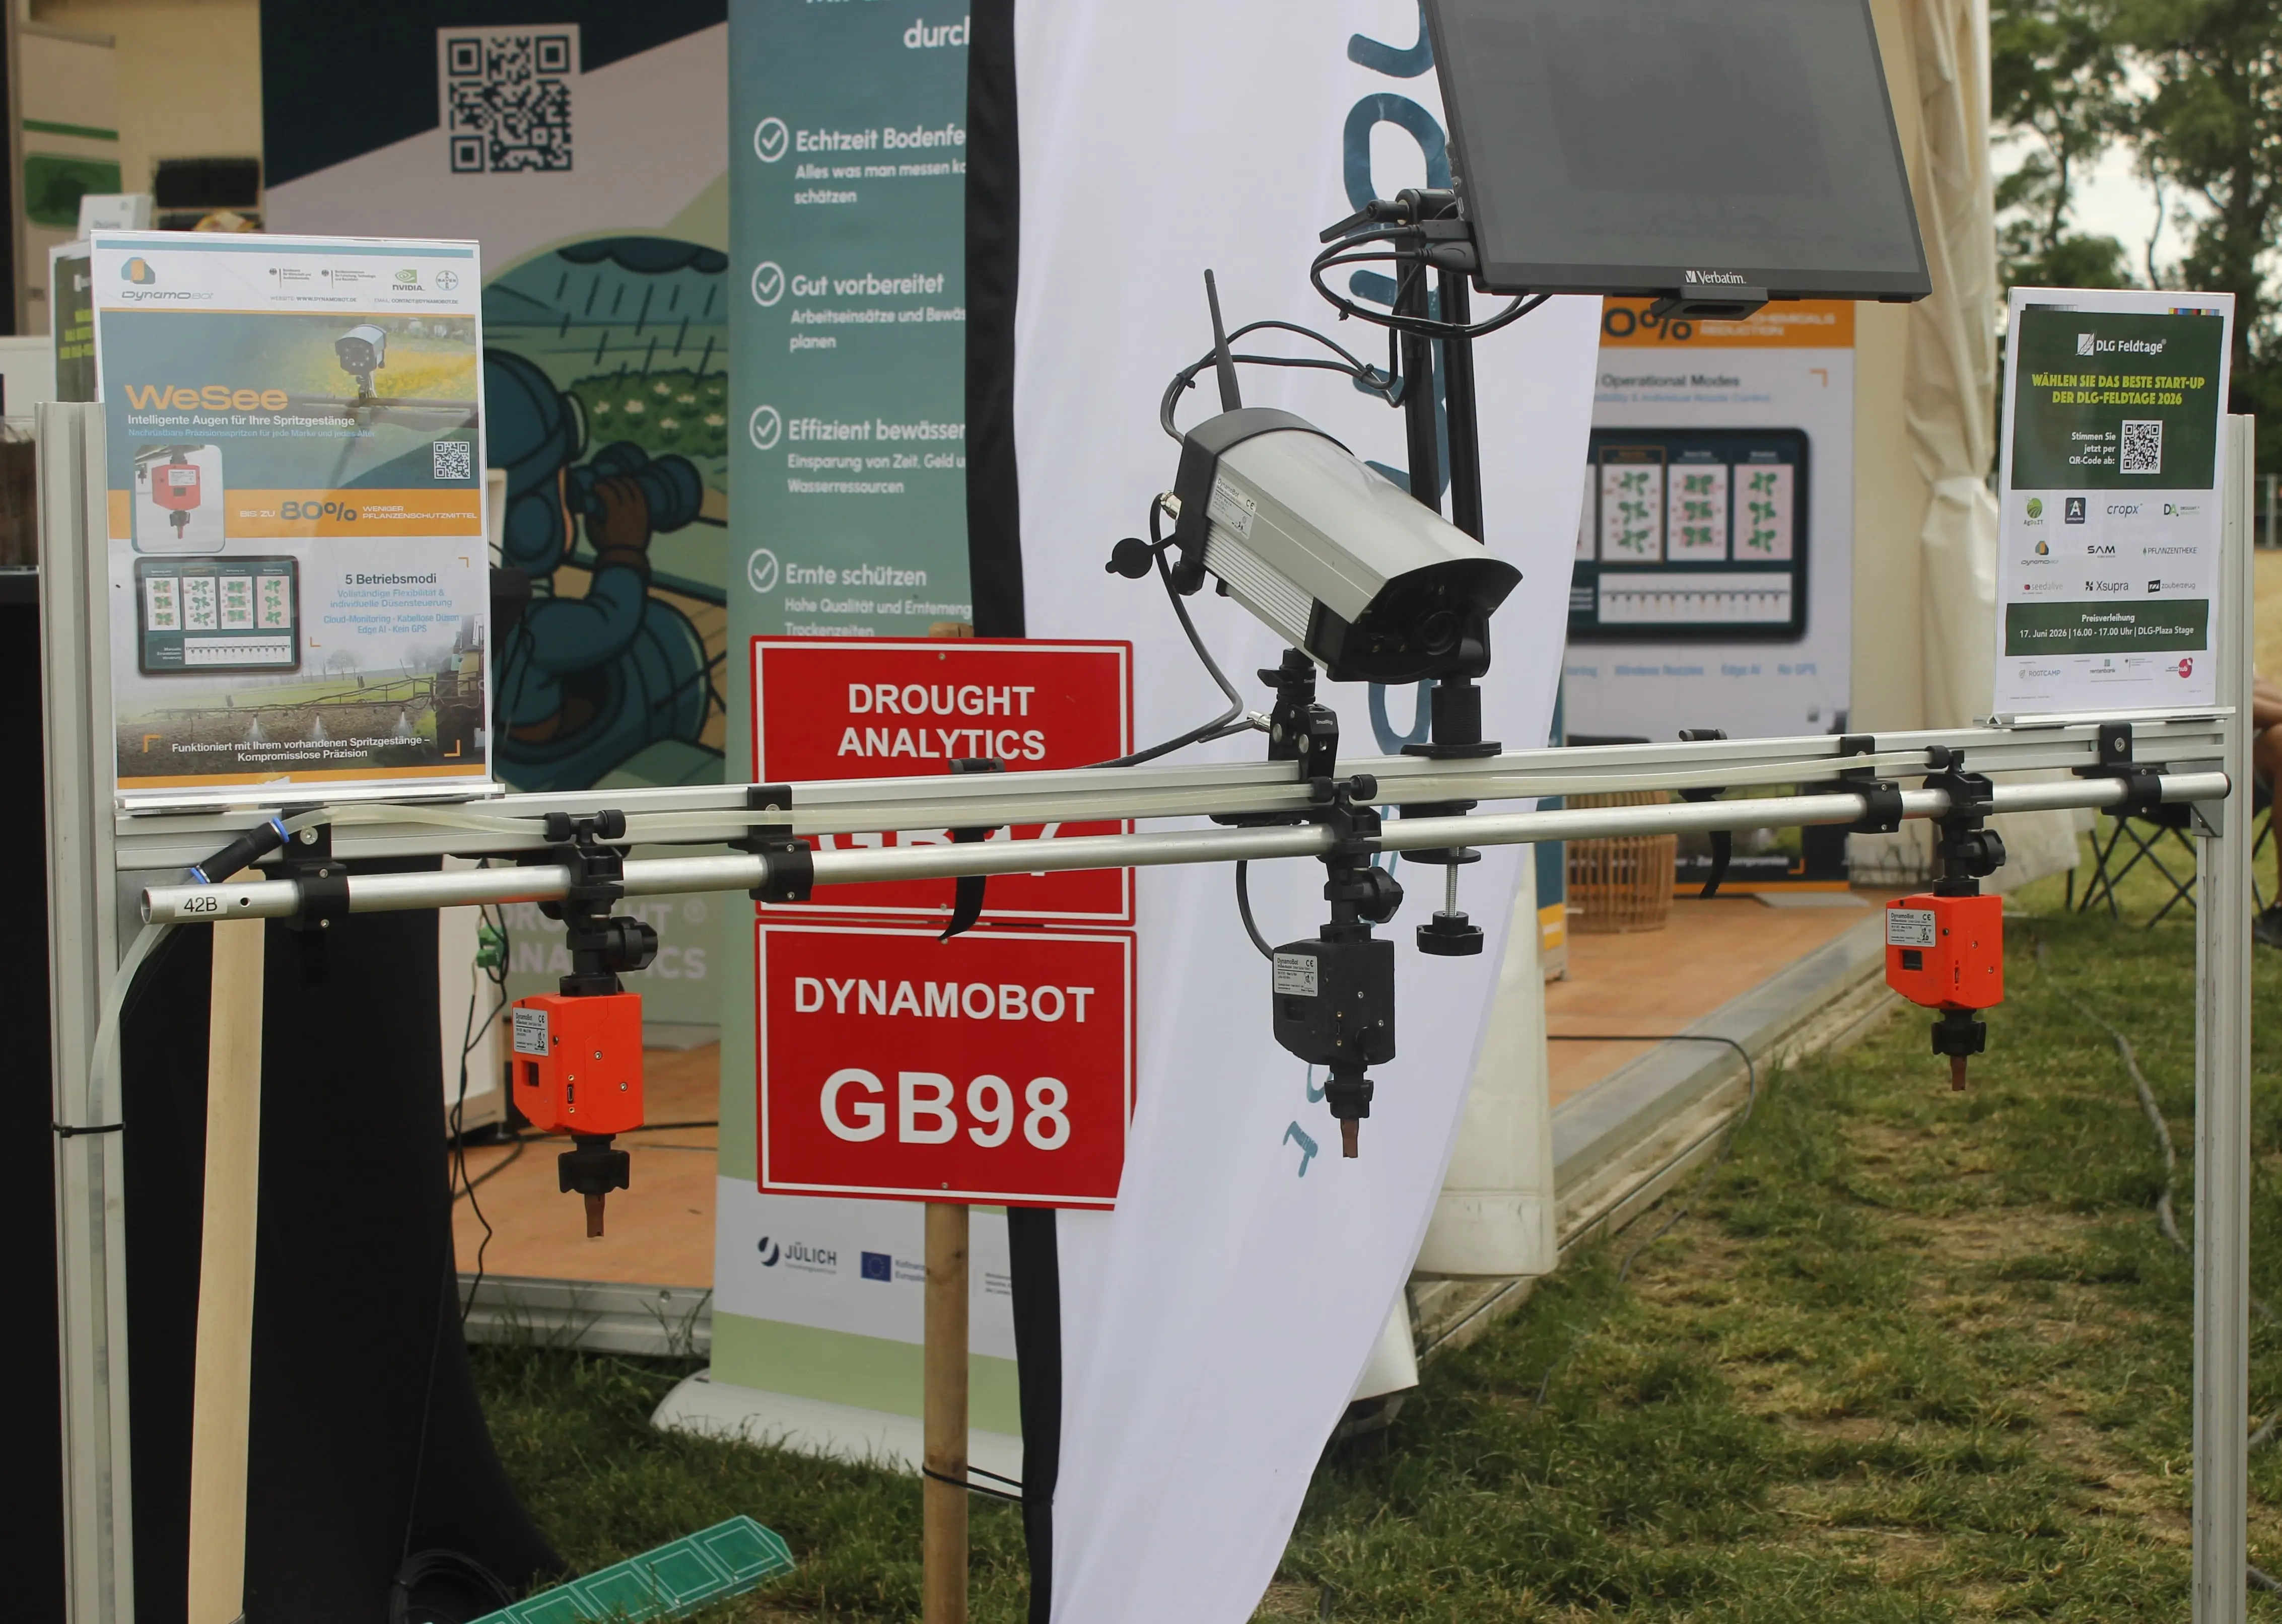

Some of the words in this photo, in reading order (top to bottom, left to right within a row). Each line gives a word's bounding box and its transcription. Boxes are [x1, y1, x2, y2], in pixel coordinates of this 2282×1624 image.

[797, 128, 878, 152] Echtzeit
[795, 164, 828, 179] Alles
[833, 166, 861, 178] was
[864, 165, 896, 177] man
[899, 163, 949, 176] messen
[794, 188, 857, 204] schätzen
[791, 275, 828, 297] Gut
[834, 273, 944, 295] vorbereitet
[791, 309, 895, 324] Arbeitseinsätze
[898, 308, 924, 322] und
[790, 333, 837, 353] planen
[2096, 340, 2115, 352] DLG
[2118, 340, 2163, 355] Feldtage
[1691, 374, 1740, 387] Modes
[2032, 372, 2077, 387] WÄHLEN
[2080, 375, 2096, 387] SIE
[2098, 376, 2119, 388] DAS
[2122, 376, 2152, 388] BESTE
[2155, 377, 2205, 389] START-UP
[125, 385, 289, 411] WeSee
[2052, 391, 2074, 403] DER
[2077, 392, 2155, 404] DLG-FELDTAGE
[2159, 392, 2182, 405] 2026
[128, 414, 189, 427] Intelligente
[193, 415, 229, 428] Augen
[231, 415, 246, 426] für
[250, 415, 270, 426] Ihre
[273, 415, 355, 429] Spritzgestänge
[789, 418, 870, 440] Effizient
[876, 418, 965, 440] bewässer
[128, 429, 183, 437] Nachrüstbare
[185, 429, 257, 438] Präzisionsspritzen
[272, 429, 289, 439] jede
[2071, 432, 2103, 441] Stimmen
[2105, 433, 2116, 441] Sie
[2084, 444, 2101, 454] jetzt
[2103, 445, 2115, 454] per
[788, 454, 862, 472] Einsparung
[866, 457, 889, 468] von
[924, 453, 954, 468] Geld
[2069, 456, 2101, 465] QR-Code
[2103, 456, 2115, 465] ab:
[788, 479, 904, 494] Wasserressourcen
[280, 501, 358, 522] 80%
[345, 574, 352, 585] 5
[356, 573, 437, 585] Betriebsmodi
[786, 563, 837, 585] Ernte
[842, 563, 926, 586] schützen
[2031, 581, 2063, 590] seedalive
[2096, 581, 2128, 593] Xsupra
[337, 590, 390, 599] Vollständige
[393, 589, 436, 597] Flexibilität
[330, 599, 379, 608] individuelle
[381, 599, 452, 608] Düsensteuerung
[785, 597, 817, 612] Hohe
[820, 598, 874, 613] Qualität
[877, 599, 901, 614] und
[905, 601, 972, 619] Erntemeng
[324, 615, 391, 624] Cloud-Monitoring
[397, 614, 434, 622] Kabellose
[436, 613, 459, 622] Düsen
[2082, 614, 2135, 623] Preisverleihung
[358, 625, 377, 635] Edge
[393, 625, 409, 633] Kein
[412, 624, 427, 632] GPS
[784, 622, 874, 637] Trockenzeiten
[2033, 629, 2047, 637] Juni
[2049, 629, 2066, 637] 2026
[2073, 628, 2092, 637] 16.00
[2099, 627, 2118, 636] 17.00
[2120, 627, 2133, 636] Uhr
[2138, 626, 2172, 635] DLG-Plaza
[2174, 626, 2193, 636] Stage
[848, 683, 1035, 716] DROUGHT
[172, 742, 232, 752] Funktioniert
[235, 741, 250, 750] mit
[253, 740, 281, 750] Ihrem
[284, 739, 347, 749] vorhandenen
[350, 736, 422, 749] Spritzgestänge
[837, 728, 1046, 760] ANALYTICS
[238, 750, 320, 762] Kompromisslose
[323, 749, 368, 759] Präzision
[184, 896, 218, 912] 42B
[795, 976, 1094, 1023] DYNAMOBOT
[819, 1068, 1071, 1151] GB98
[785, 1241, 837, 1266] JÜLICH
